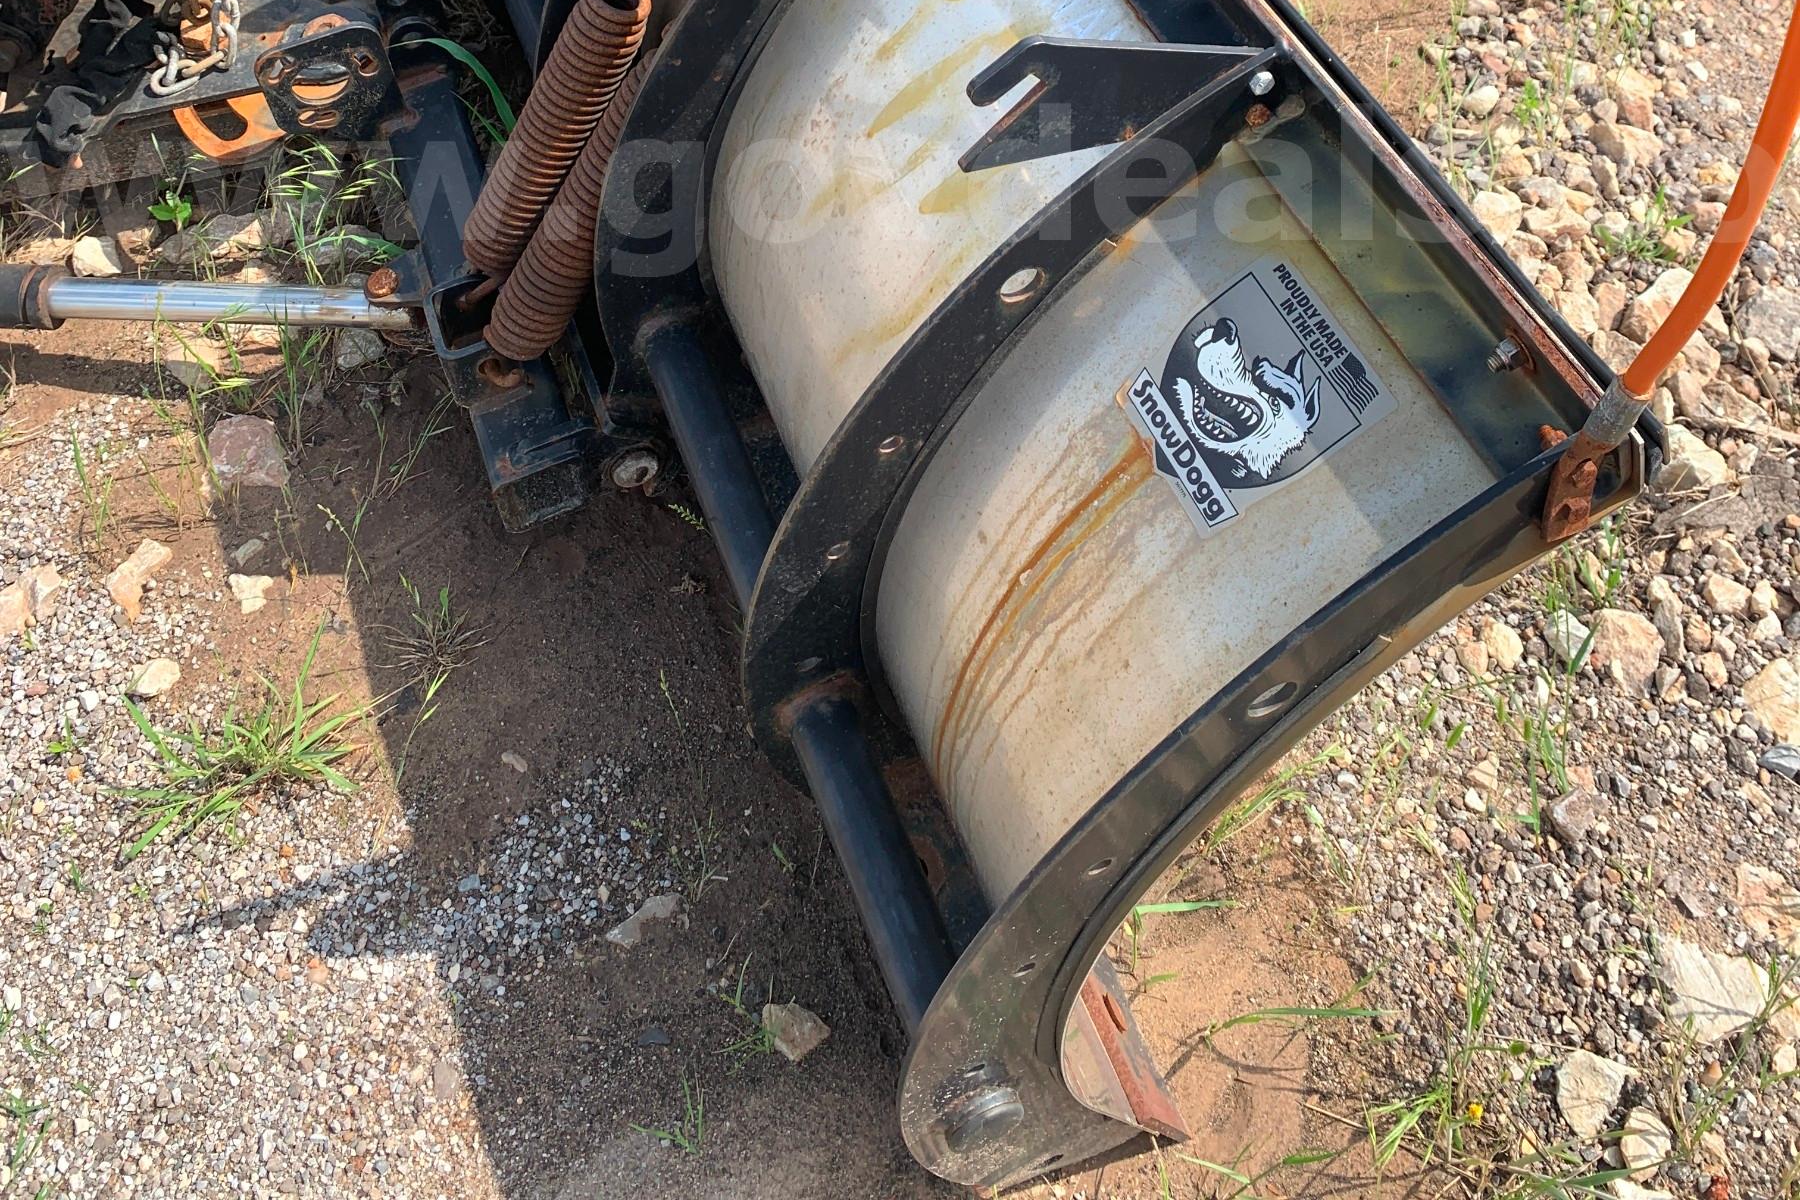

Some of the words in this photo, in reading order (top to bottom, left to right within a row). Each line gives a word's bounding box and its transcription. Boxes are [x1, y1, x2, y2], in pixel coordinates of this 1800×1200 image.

[1272, 263, 1322, 321] PROUDLY
[1312, 318, 1349, 359] MADE
[1279, 297, 1298, 316] IN
[1291, 312, 1316, 341] THE
[1309, 337, 1334, 368] USA
[1133, 379, 1225, 522] SnowDogg
